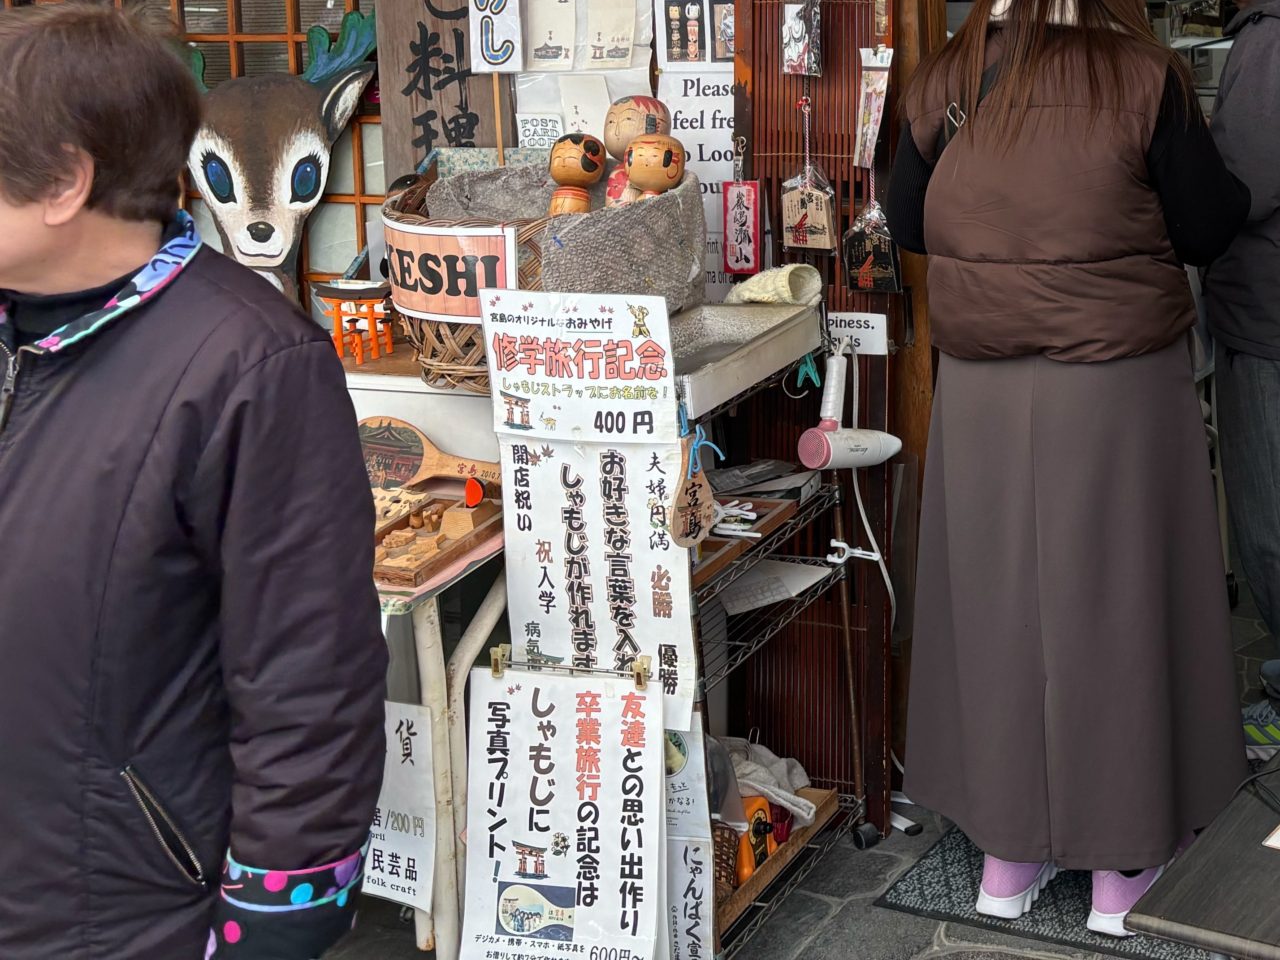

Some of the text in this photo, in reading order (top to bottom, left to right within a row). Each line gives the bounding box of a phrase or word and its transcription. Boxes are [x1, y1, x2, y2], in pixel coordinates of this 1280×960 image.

[520, 118, 559, 129] POST
[521, 128, 560, 138] CARD
[672, 109, 735, 130] feel fre
[697, 143, 735, 163] Loo
[492, 332, 668, 381] 修学旅行記念
[593, 410, 654, 435] 400 円
[511, 444, 533, 532] 開店祝い
[645, 451, 670, 552] 夫婦円満
[684, 481, 704, 540] 宮島
[560, 461, 598, 675] しゃもじが作れます
[650, 564, 674, 620] 必勝
[657, 643, 679, 696] 優勝
[528, 687, 557, 833] しゃもじに
[486, 701, 512, 883] 写真プリント!
[575, 690, 602, 908] 卒業旅行の記念は
[619, 691, 647, 938] 友達との思い出作り
[370, 832, 386, 841] orii
[366, 875, 417, 897] folk craft
[371, 848, 418, 882] 民芸品
[682, 844, 704, 960] にゃんぱく宣
